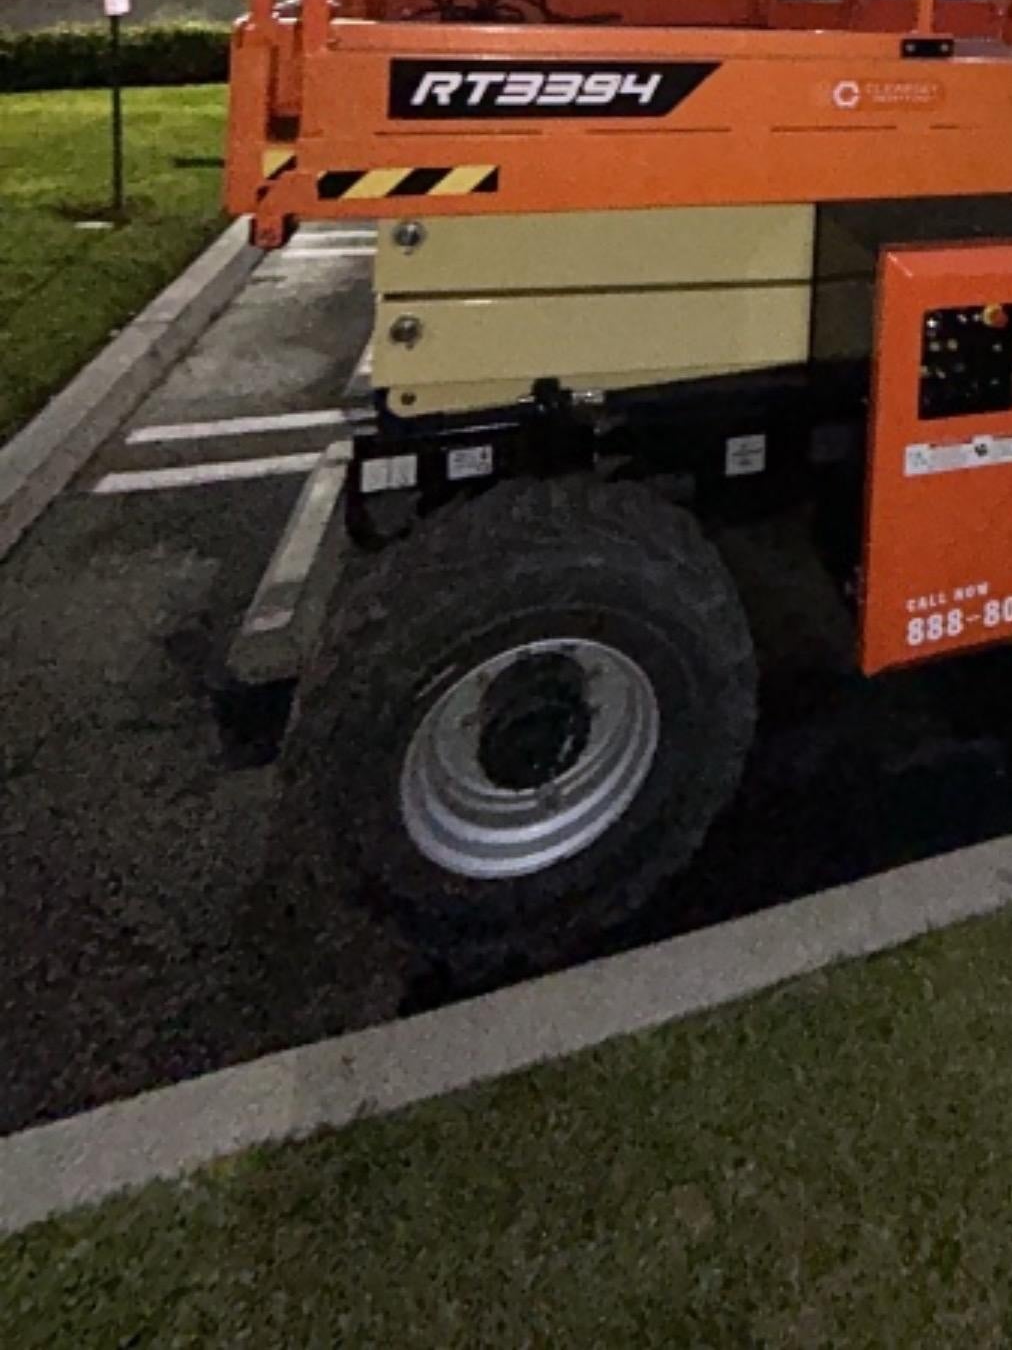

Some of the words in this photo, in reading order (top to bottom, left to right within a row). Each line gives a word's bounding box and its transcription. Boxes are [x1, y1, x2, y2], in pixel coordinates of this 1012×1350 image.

[410, 71, 663, 106] RT3394
[906, 592, 946, 613] CALL
[953, 581, 988, 601] NOW
